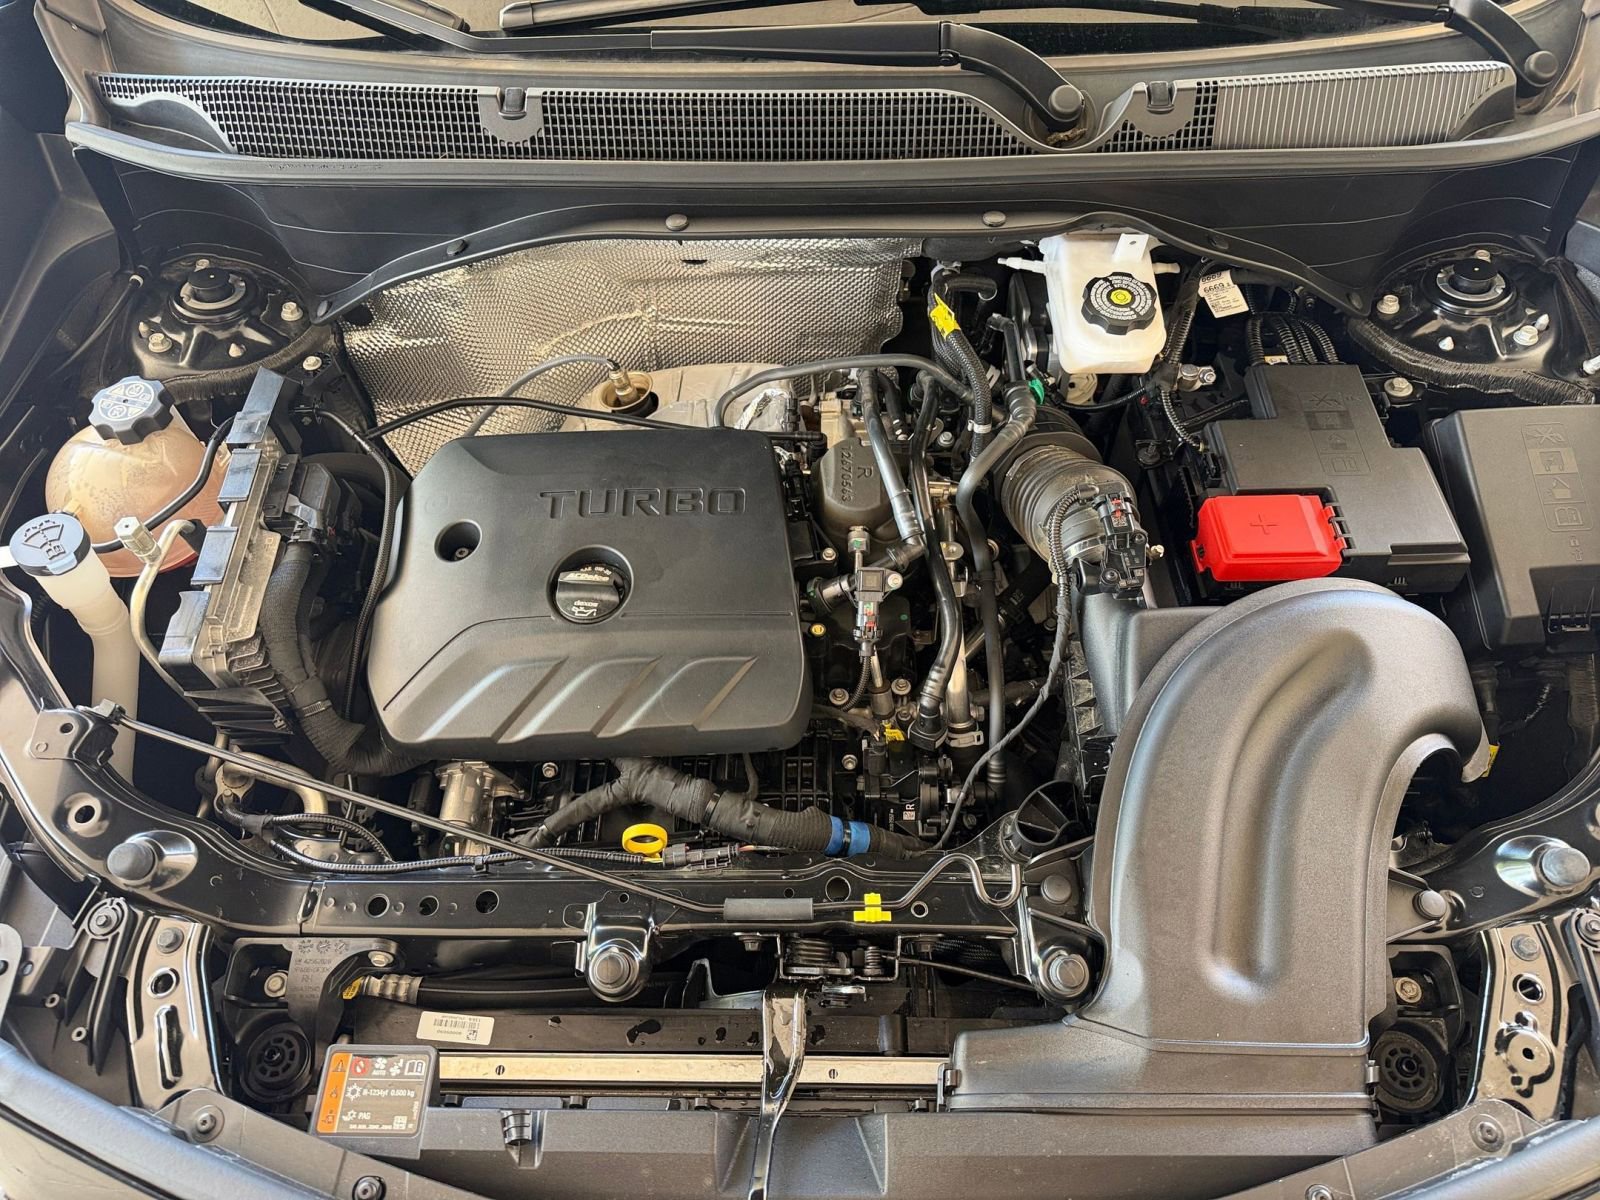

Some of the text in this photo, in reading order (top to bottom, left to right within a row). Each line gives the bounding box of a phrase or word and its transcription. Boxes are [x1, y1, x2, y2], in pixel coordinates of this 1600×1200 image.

[858, 466, 873, 479] R
[539, 488, 746, 519] TURBO
[357, 1112, 371, 1120] PAG
